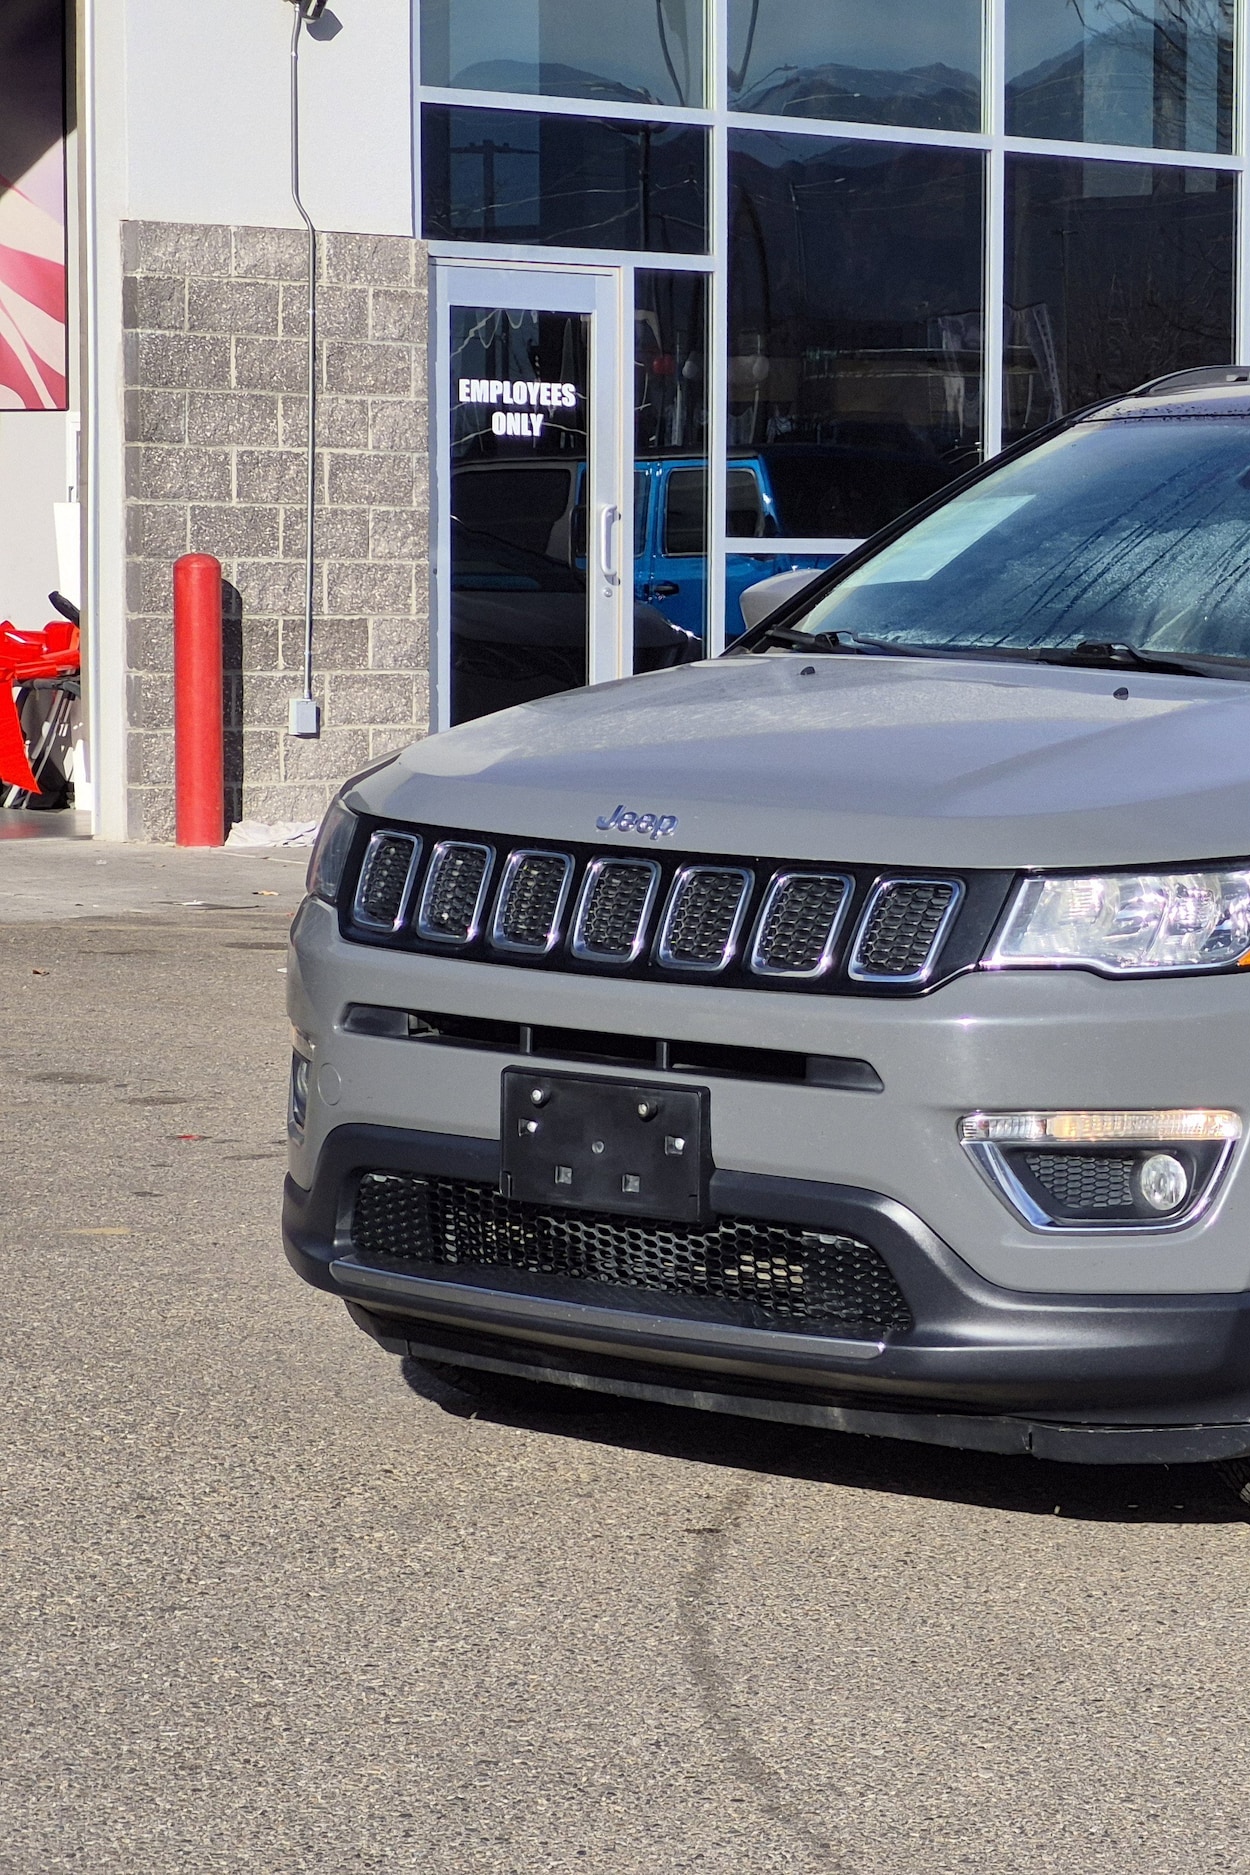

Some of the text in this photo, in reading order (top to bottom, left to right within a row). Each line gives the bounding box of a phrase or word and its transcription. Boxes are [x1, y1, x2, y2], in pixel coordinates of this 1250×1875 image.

[458, 378, 577, 407] EMPLOYEES
[491, 411, 544, 437] ONLY
[595, 804, 679, 841] Jeep
